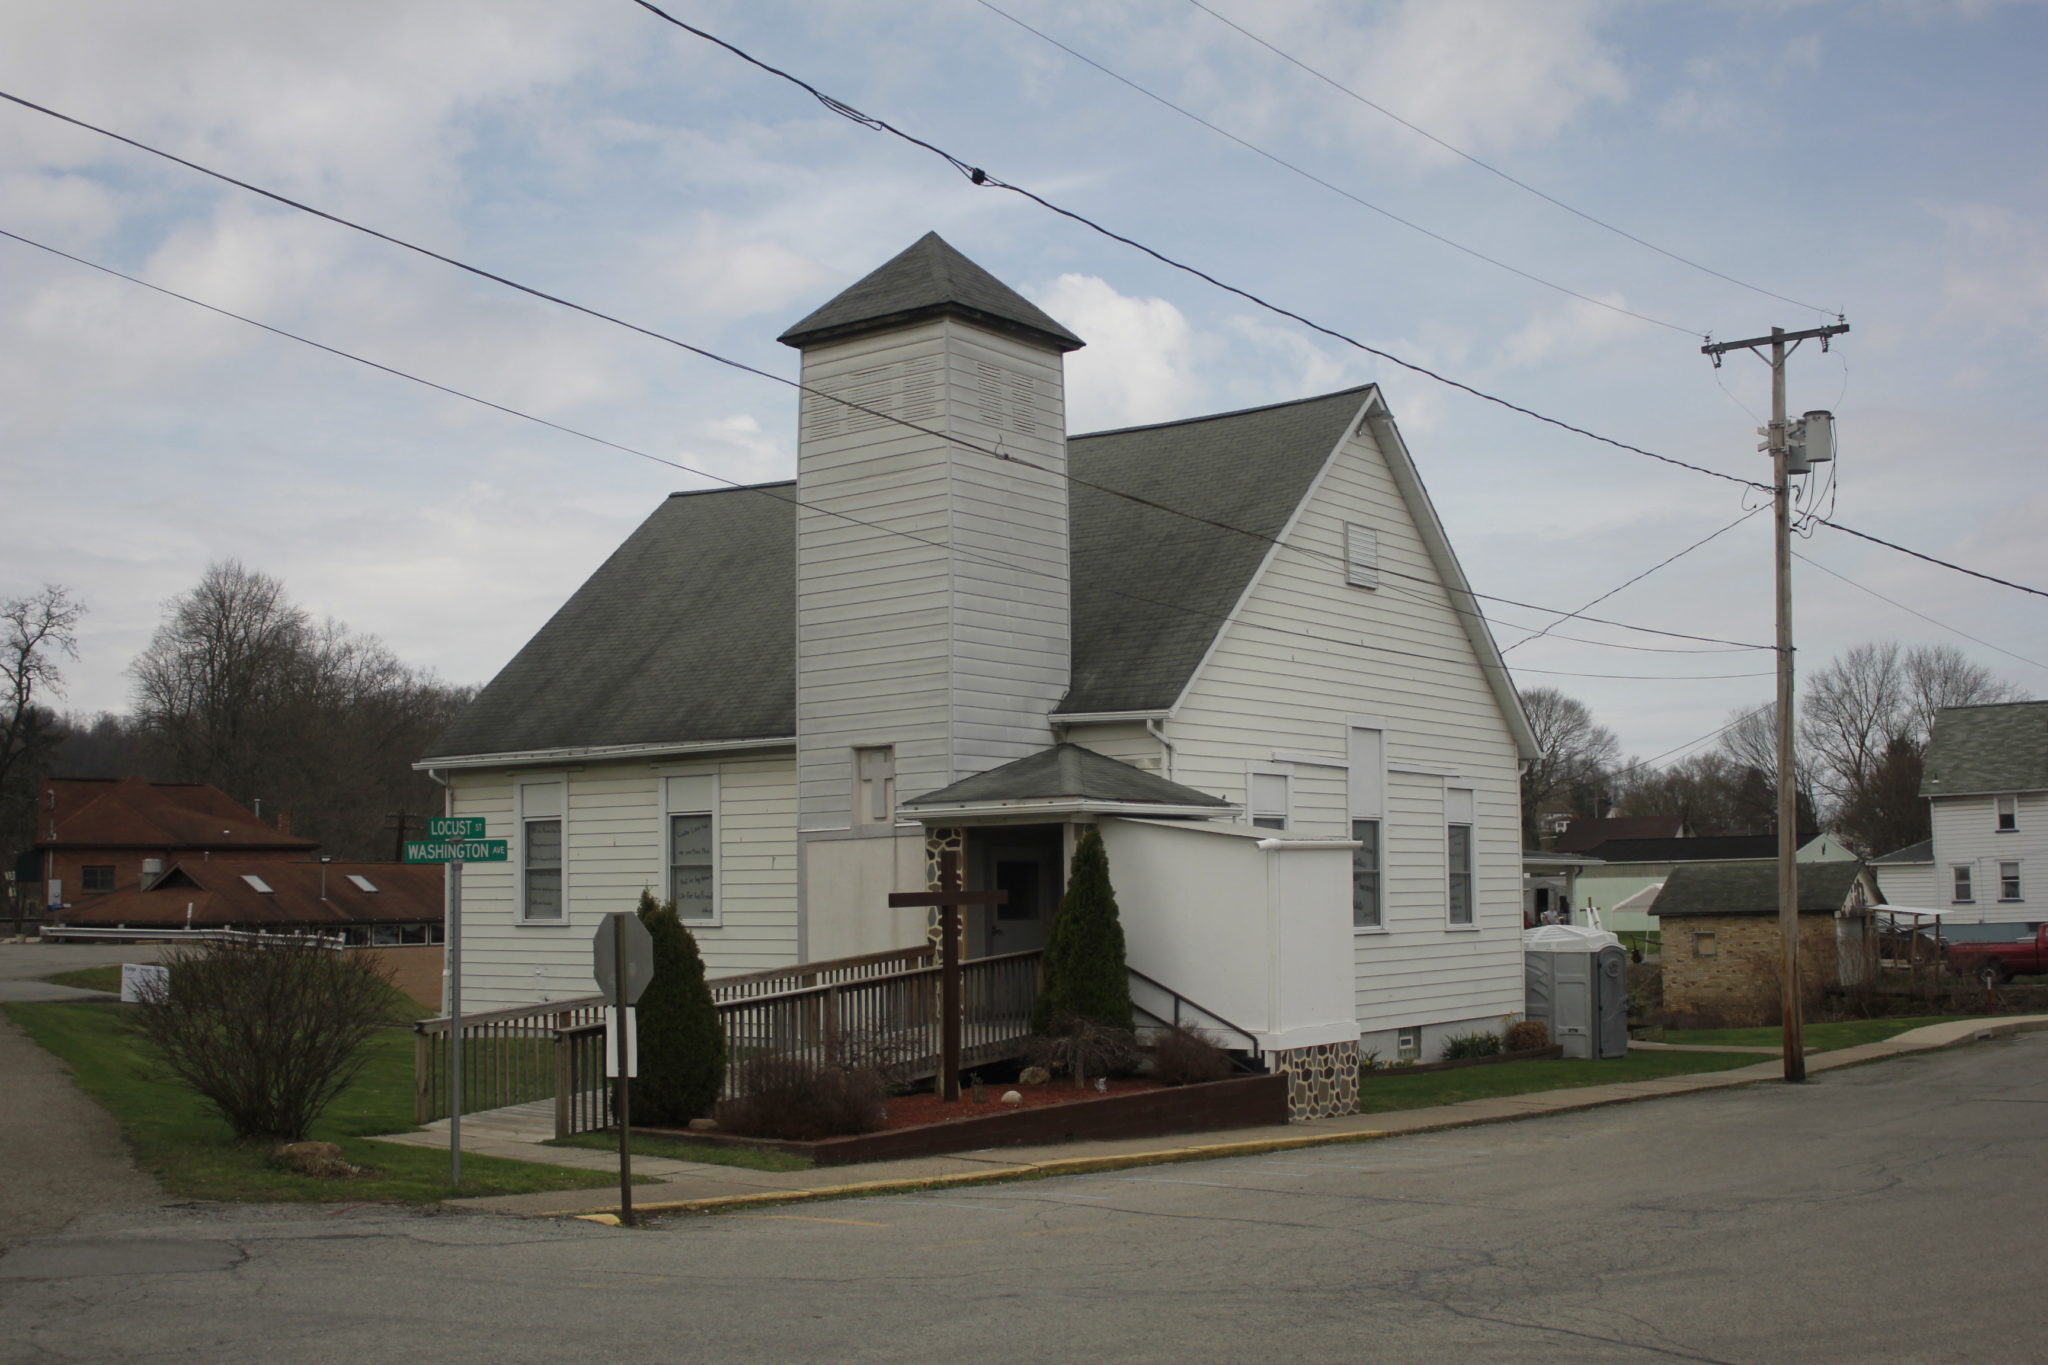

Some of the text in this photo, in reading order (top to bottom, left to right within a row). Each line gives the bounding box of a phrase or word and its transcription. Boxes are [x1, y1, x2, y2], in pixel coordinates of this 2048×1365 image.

[431, 820, 482, 836] LOCUST ST
[408, 843, 505, 860] WASHINGTON AVE
